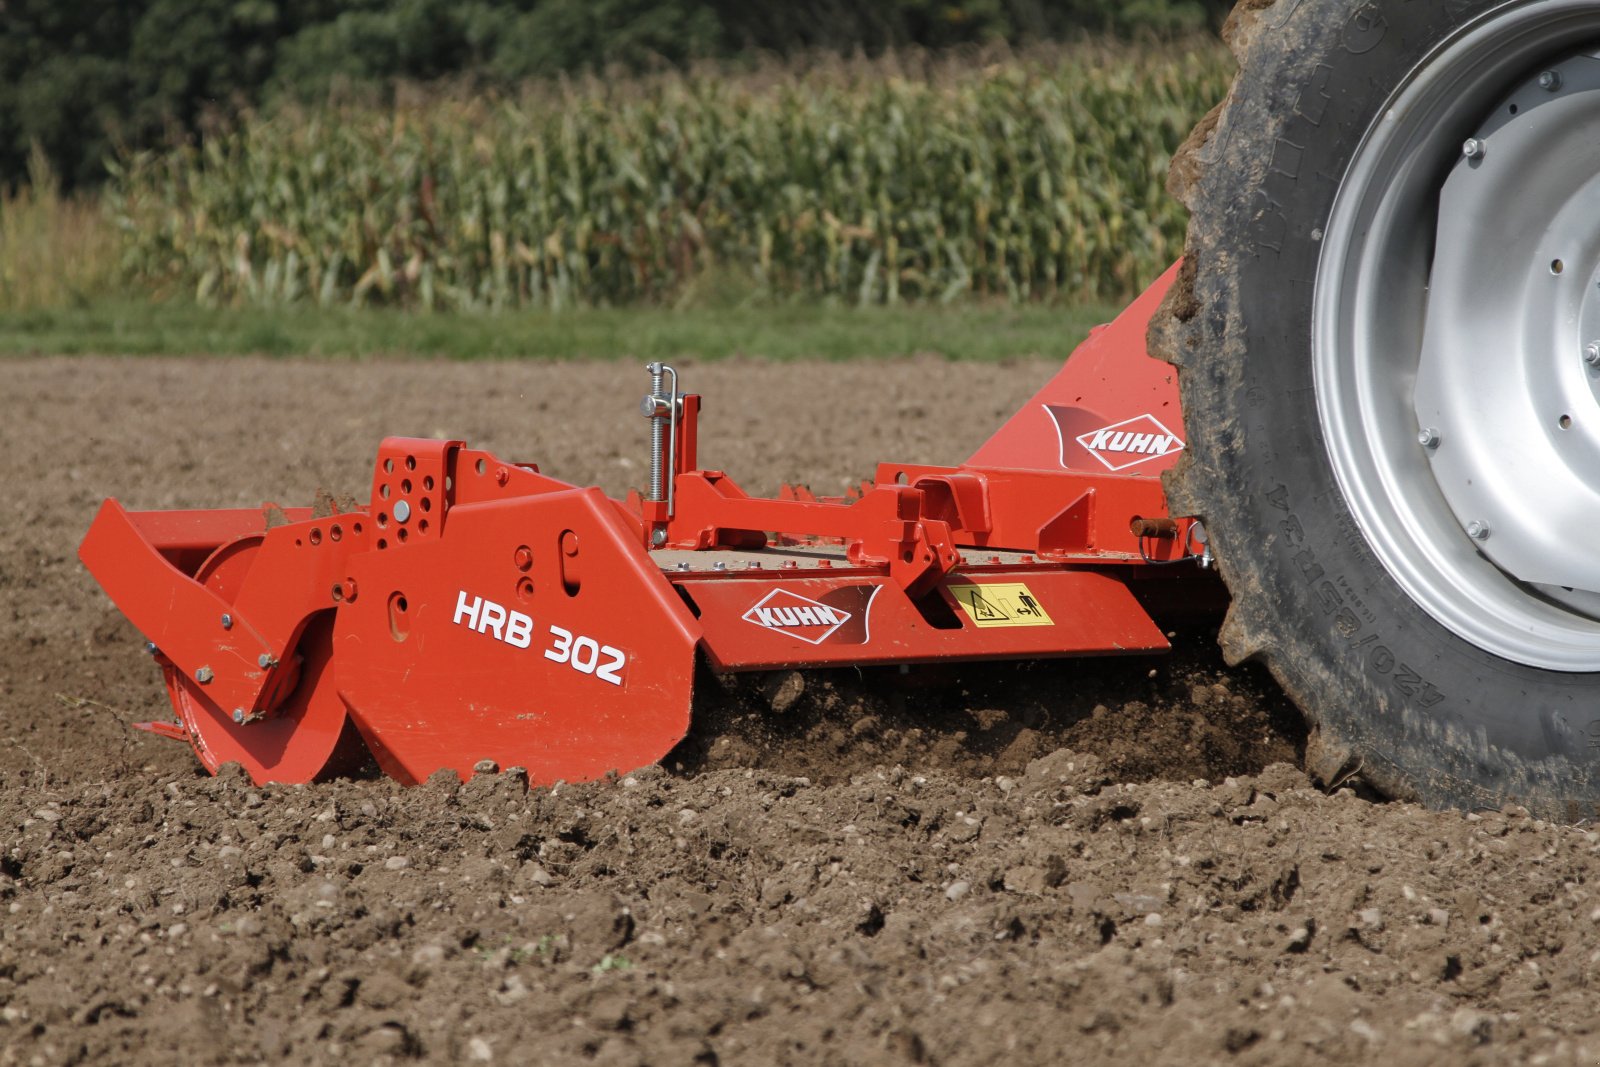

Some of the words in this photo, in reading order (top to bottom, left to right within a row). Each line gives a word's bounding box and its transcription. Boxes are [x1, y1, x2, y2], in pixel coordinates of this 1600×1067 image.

[1088, 430, 1175, 456] KUHN
[753, 605, 841, 628] KUHN
[453, 590, 534, 649] HRB
[544, 624, 626, 686] 302
